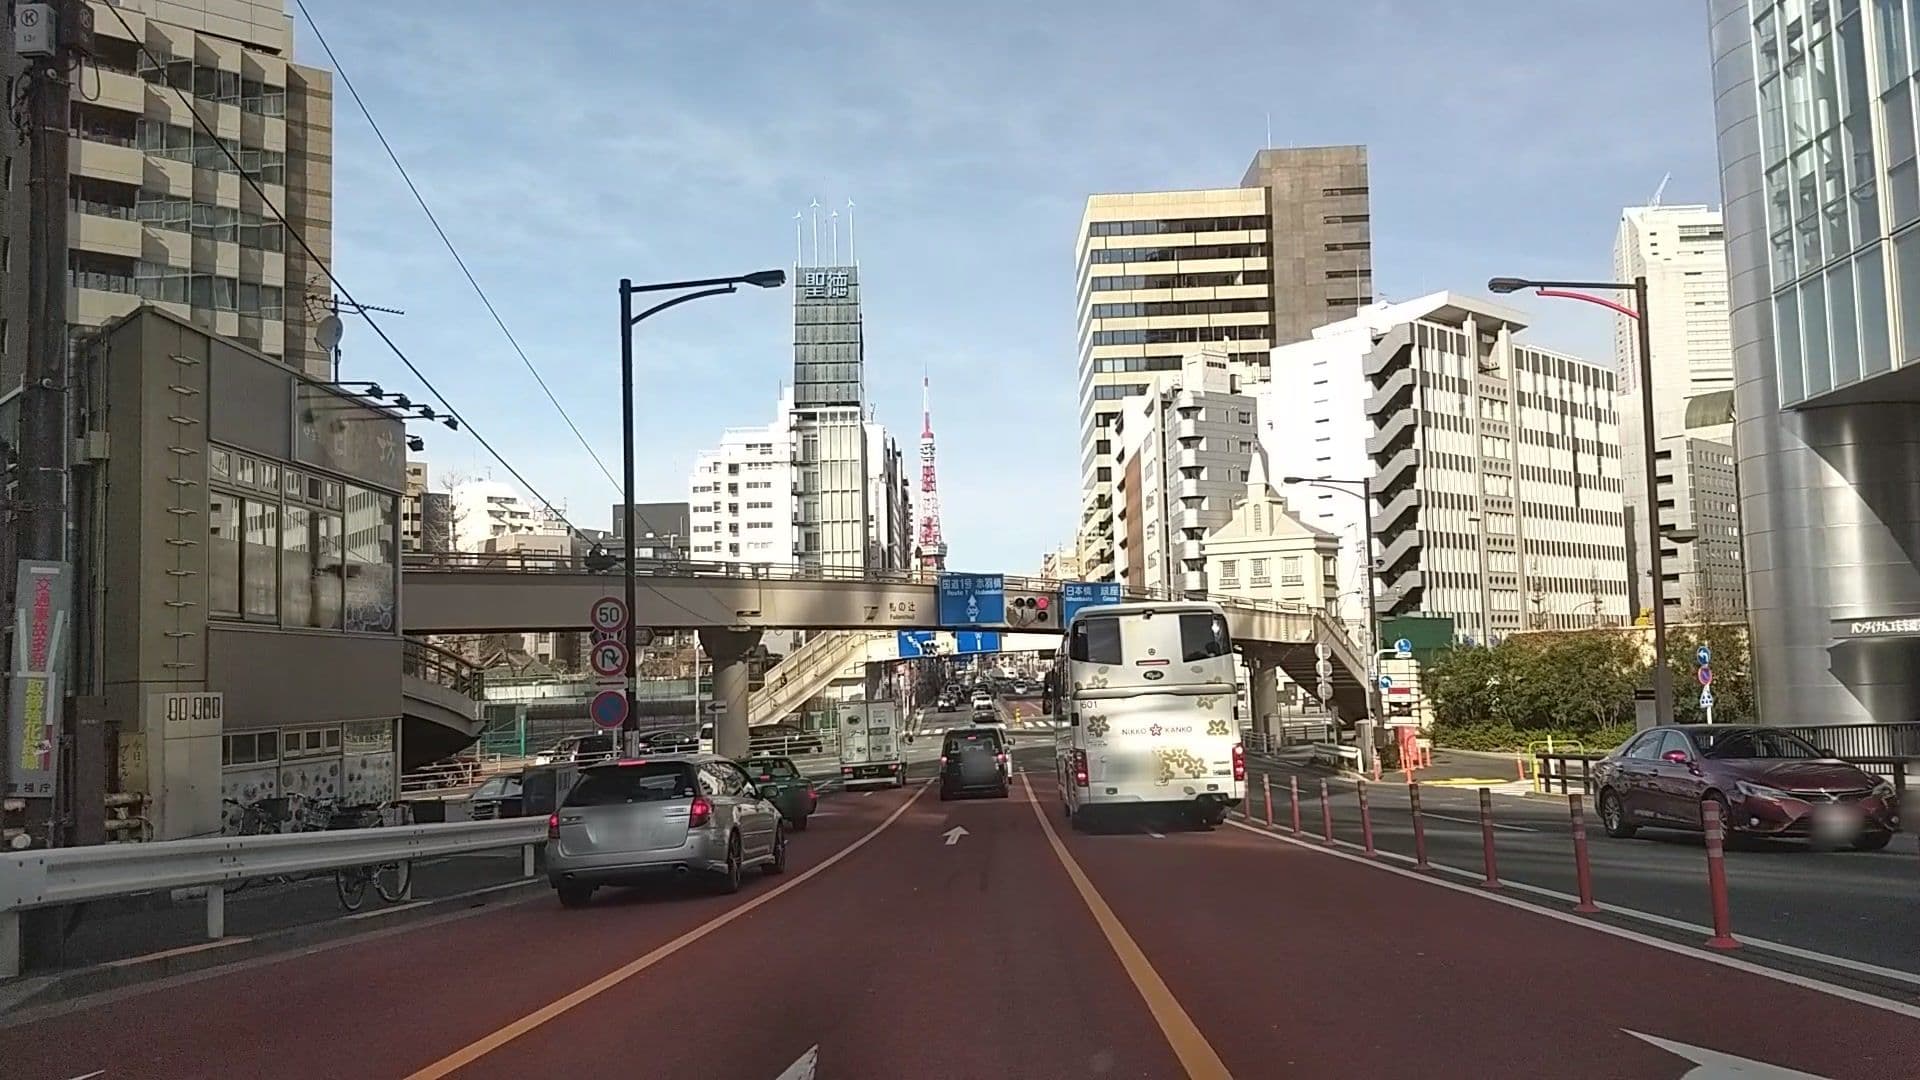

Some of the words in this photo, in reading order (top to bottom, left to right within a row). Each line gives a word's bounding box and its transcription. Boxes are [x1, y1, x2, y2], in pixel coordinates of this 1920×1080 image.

[599, 606, 620, 623] 50
[1081, 701, 1098, 710] 601
[1121, 728, 1147, 736] NIKKO
[1164, 726, 1193, 734] KANKO
